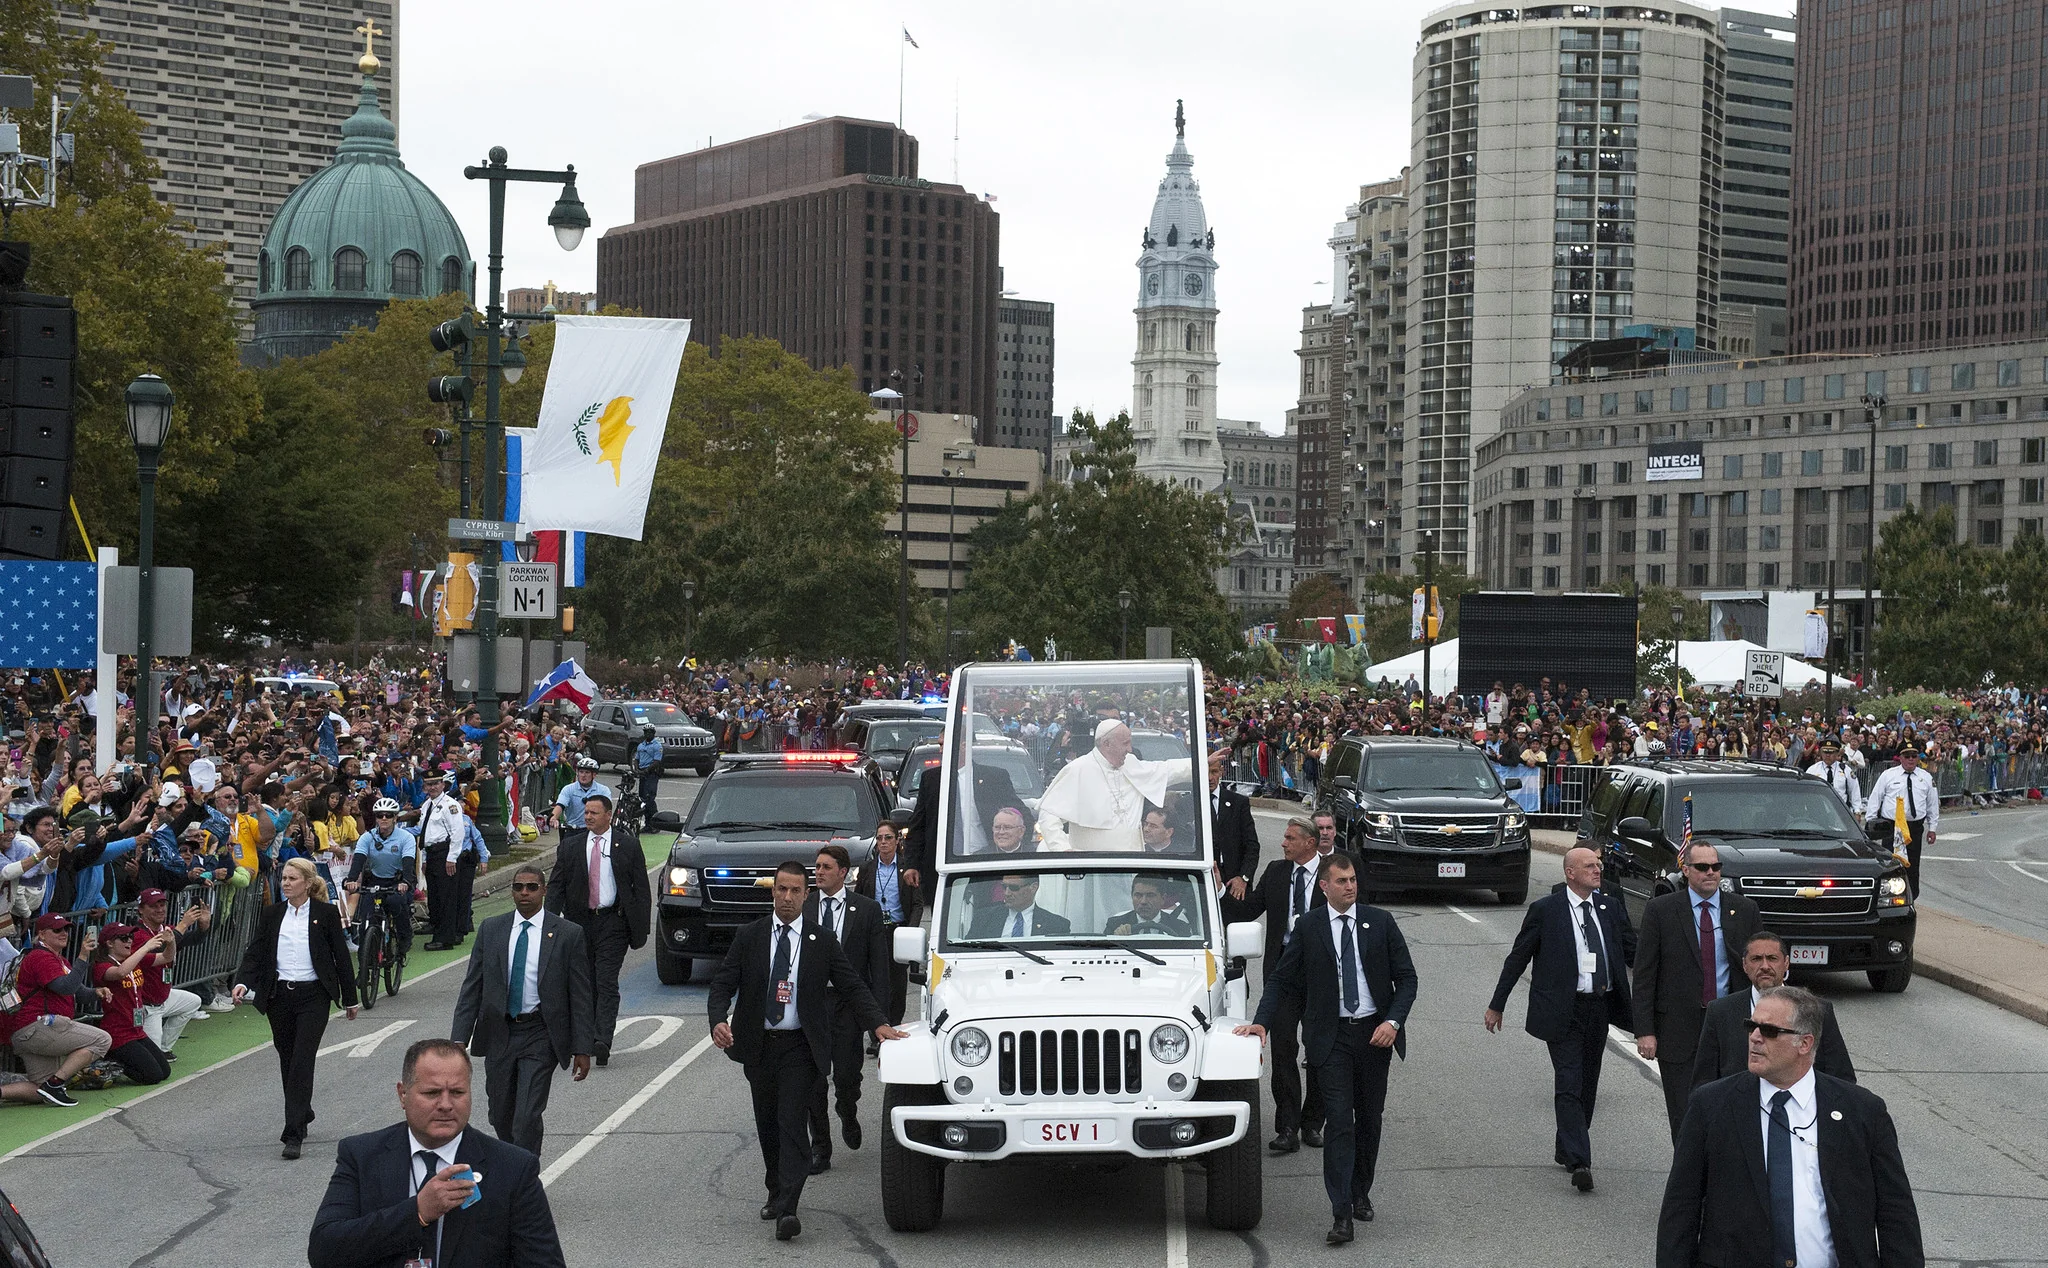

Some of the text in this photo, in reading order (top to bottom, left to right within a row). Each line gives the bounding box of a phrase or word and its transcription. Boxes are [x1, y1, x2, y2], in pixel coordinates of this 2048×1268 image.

[1648, 454, 1700, 468] INTECH
[465, 521, 500, 530] CYPRUS
[510, 567, 548, 575] PARKWAY
[509, 575, 550, 583] LOCATION
[514, 587, 544, 612] N-1
[1752, 653, 1779, 664] STOP
[1748, 683, 1769, 694] RED
